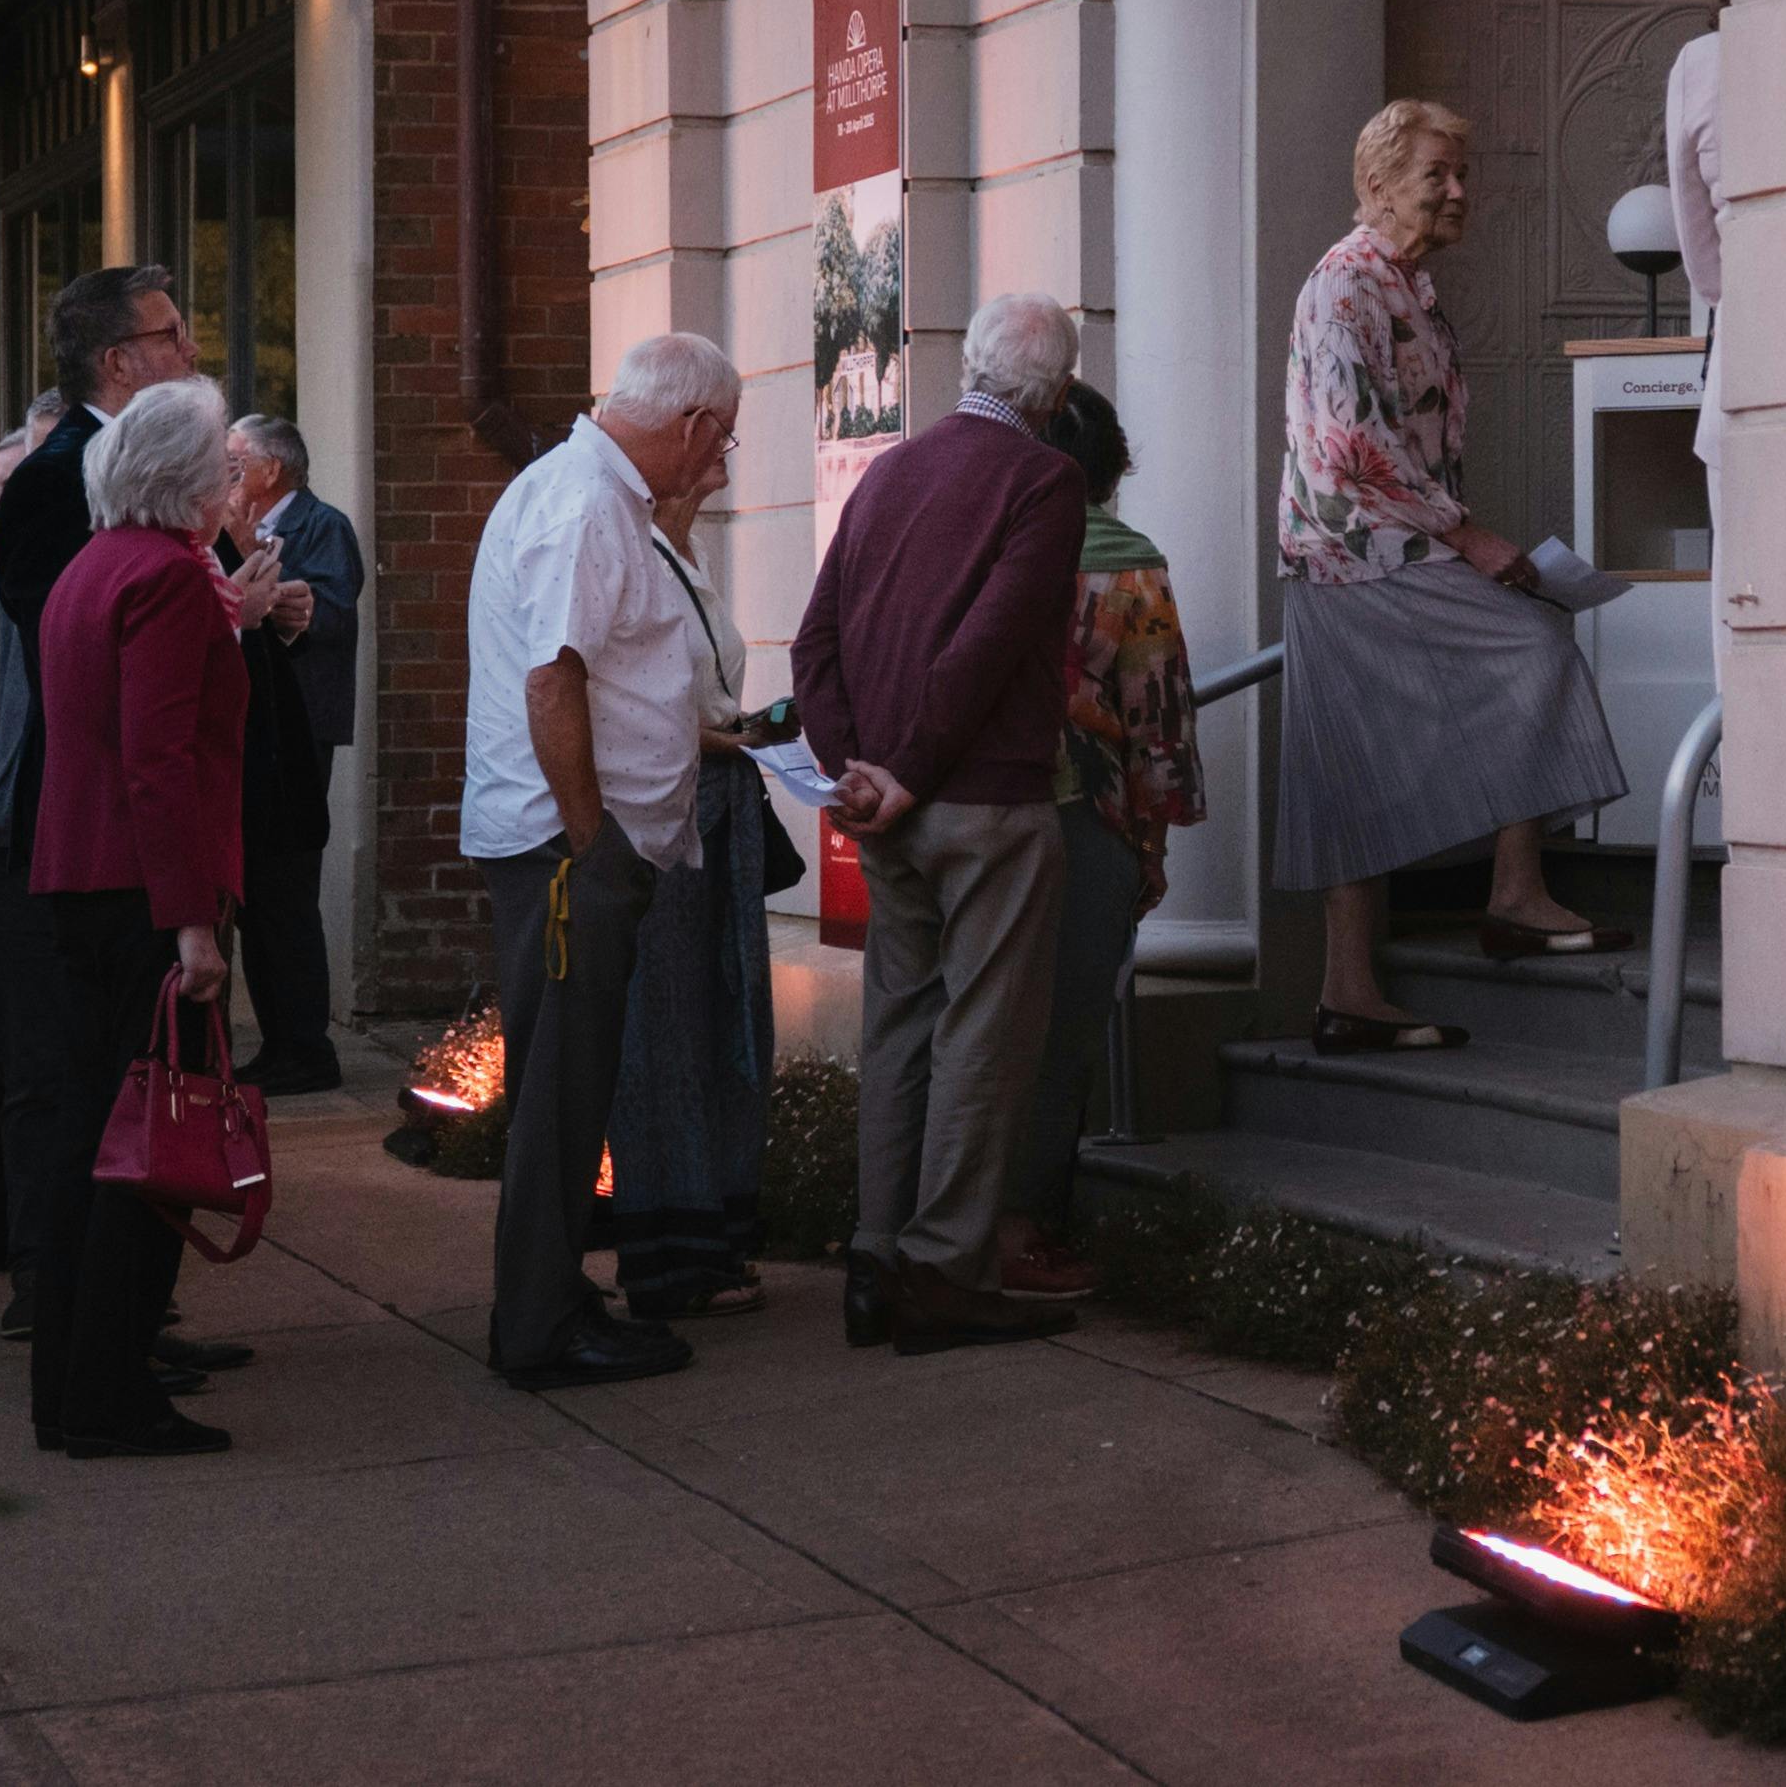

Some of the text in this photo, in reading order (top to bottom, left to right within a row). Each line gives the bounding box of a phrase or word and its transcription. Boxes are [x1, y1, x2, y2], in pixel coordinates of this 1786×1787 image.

[828, 46, 884, 89] HANDA OPERA
[826, 70, 888, 115] AT MILLTHORPE
[1622, 380, 1698, 395] Concierge,
